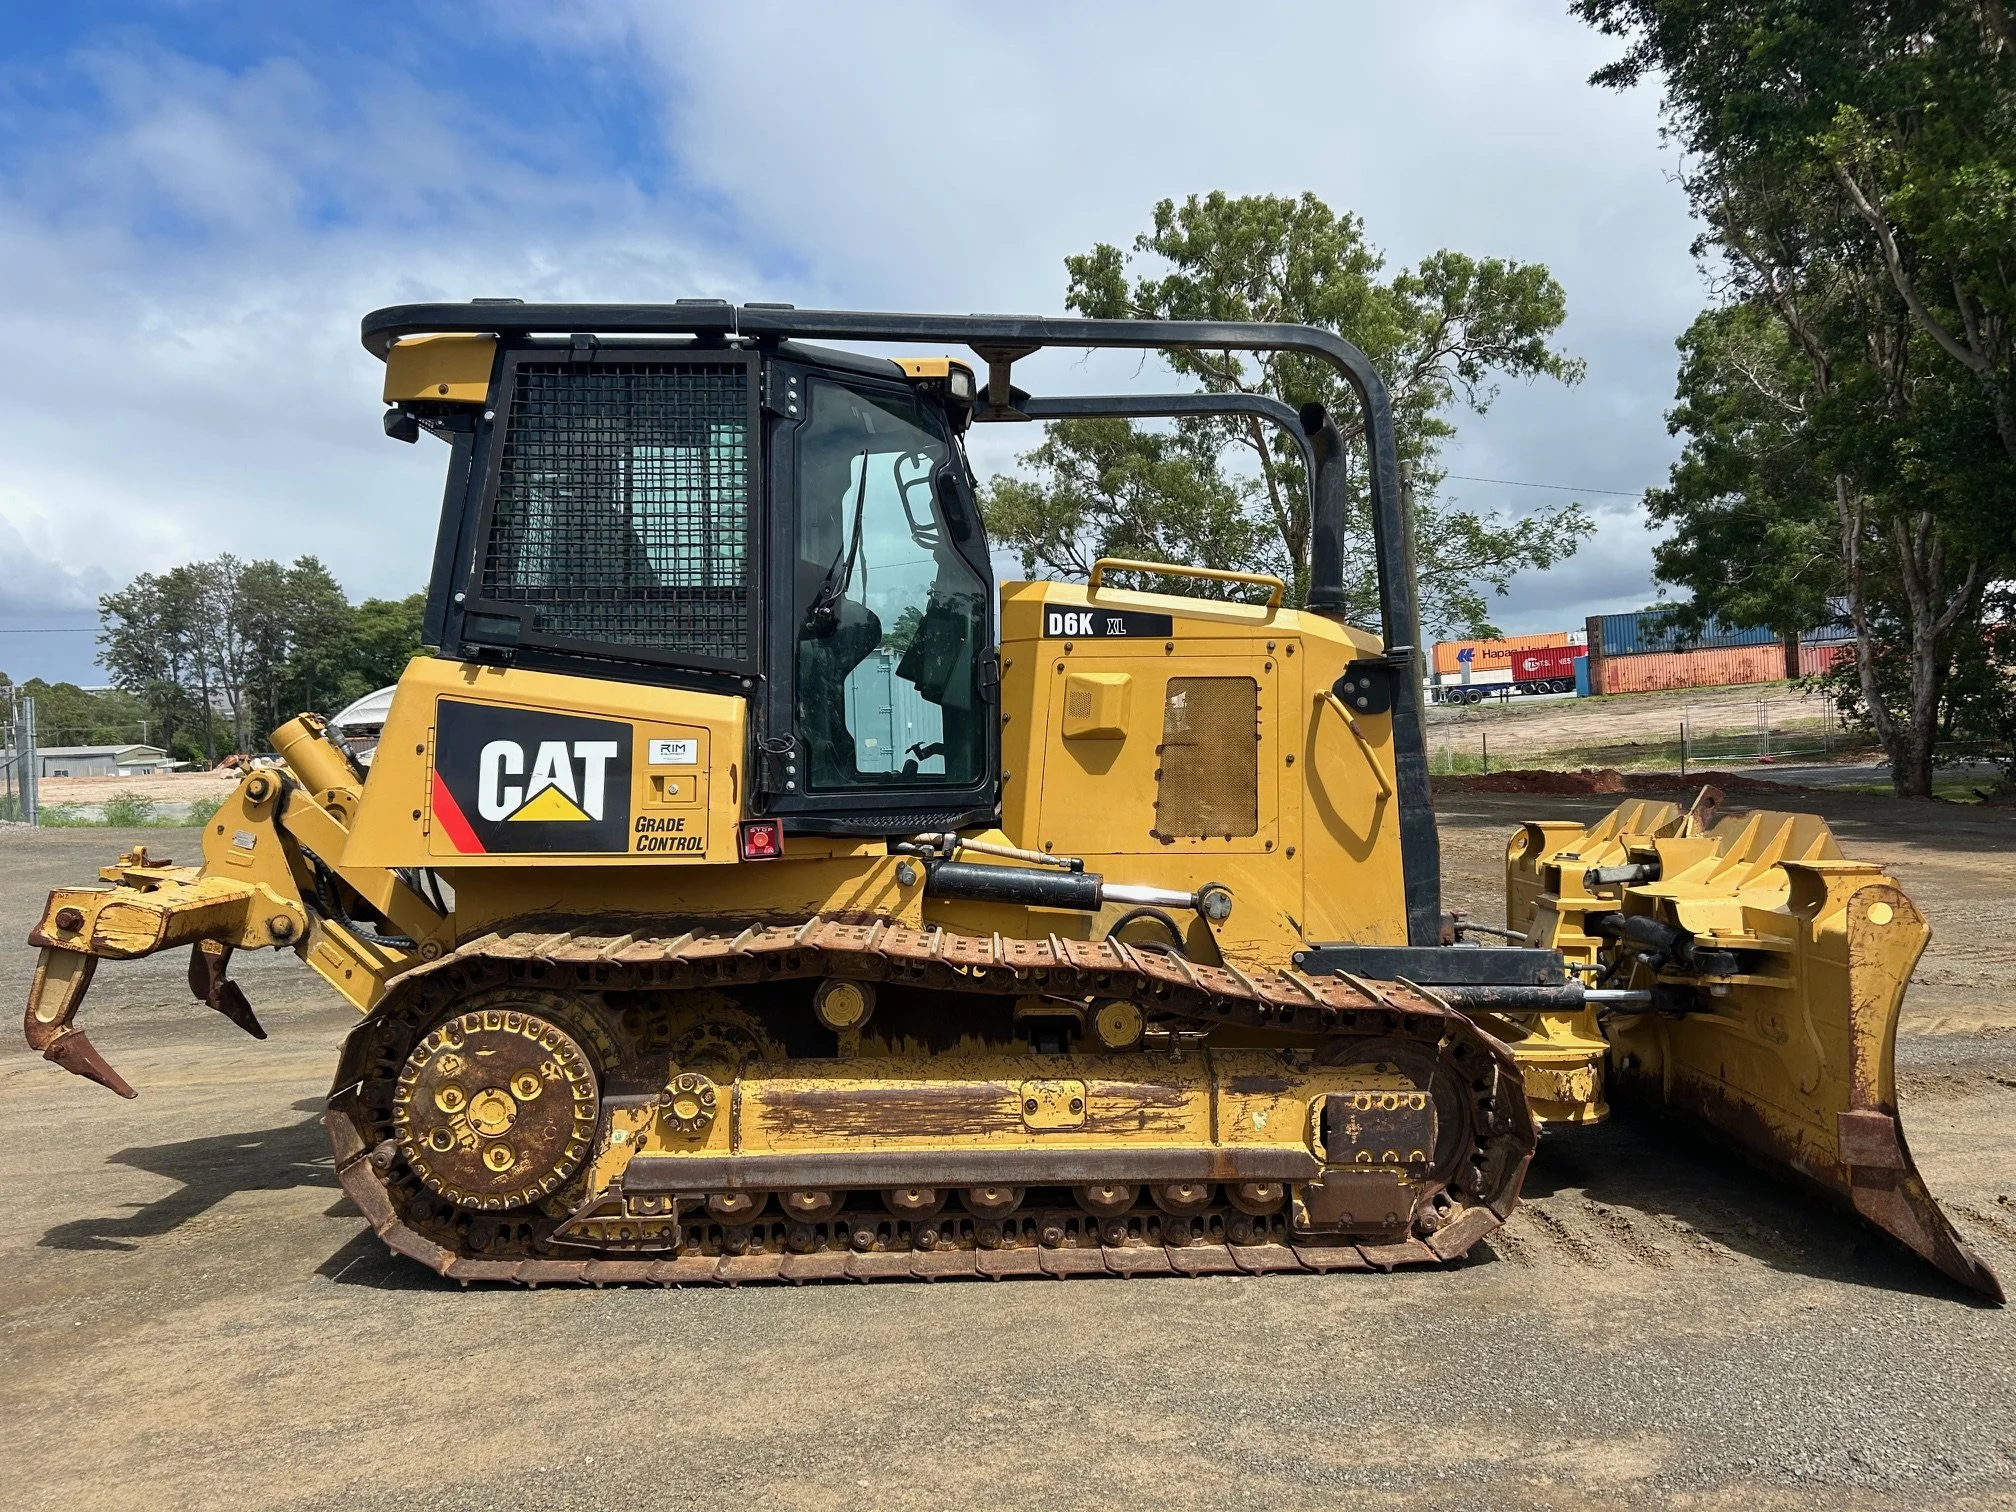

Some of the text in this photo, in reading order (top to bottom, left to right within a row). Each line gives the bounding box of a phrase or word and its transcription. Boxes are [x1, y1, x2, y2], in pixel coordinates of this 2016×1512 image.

[1049, 612, 1127, 635] D6K XL
[660, 744, 686, 753] RIM
[477, 740, 618, 822] CAT
[635, 816, 686, 833] GRADE
[636, 835, 704, 851] CONTROL
